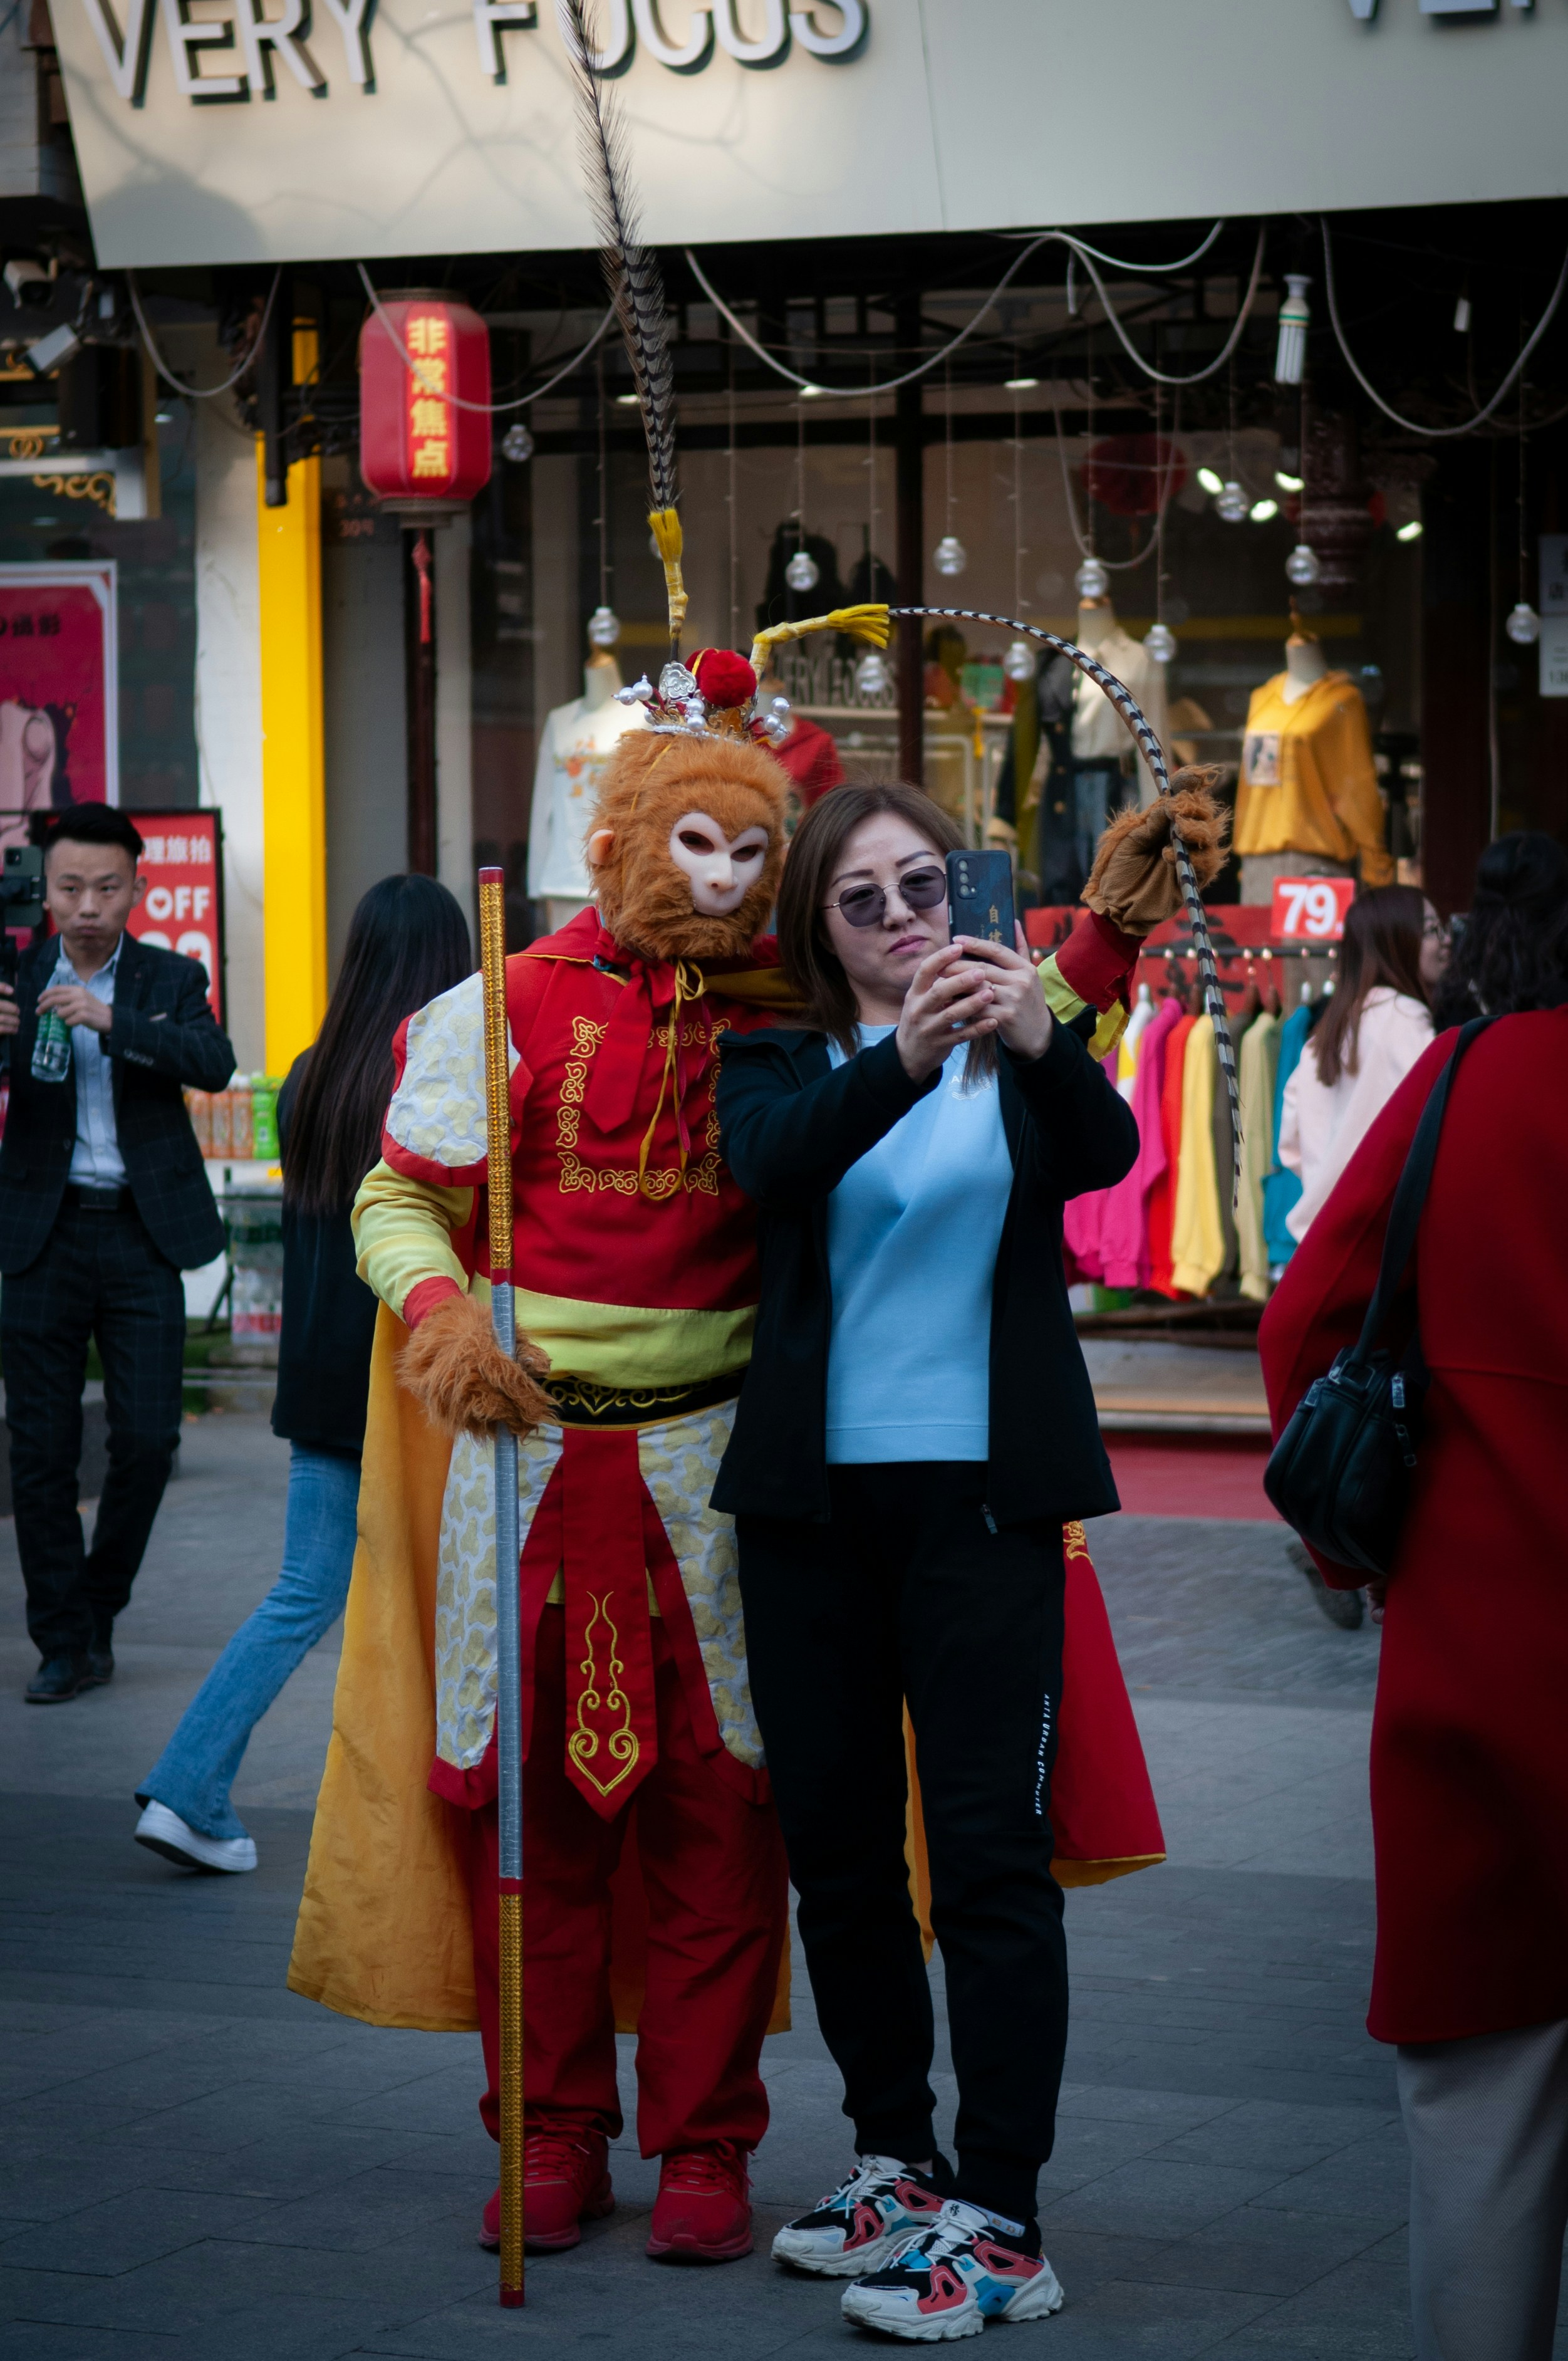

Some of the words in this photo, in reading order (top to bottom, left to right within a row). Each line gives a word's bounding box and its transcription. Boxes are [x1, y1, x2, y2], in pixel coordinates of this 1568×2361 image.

[82, 0, 376, 104] VERY
[408, 316, 449, 478] 非常焦点
[137, 836, 211, 864] 理旅拍
[145, 886, 210, 921] OFF
[1279, 883, 1337, 935] 79
[1038, 1722, 1050, 1757] URBAN
[1035, 1760, 1046, 1815] COMMUTER
